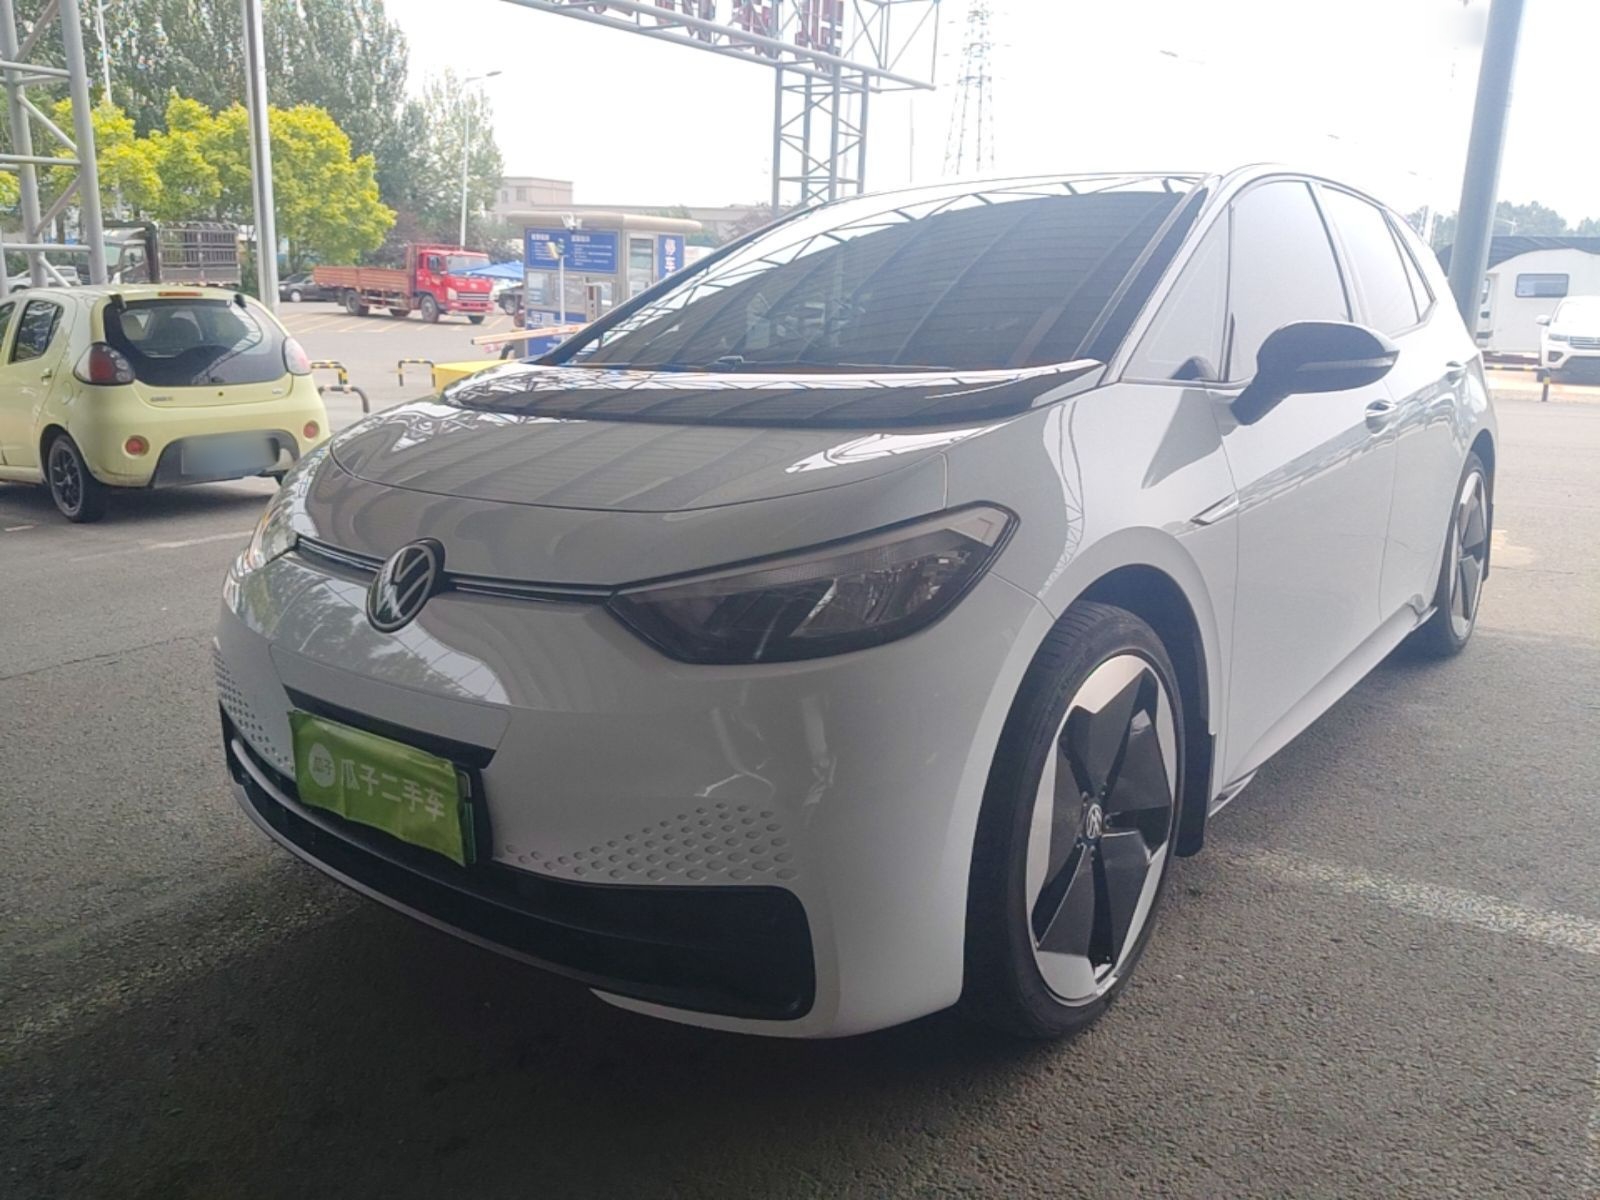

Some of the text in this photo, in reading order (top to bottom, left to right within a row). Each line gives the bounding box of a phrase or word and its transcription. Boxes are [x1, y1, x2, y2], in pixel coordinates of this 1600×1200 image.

[341, 759, 445, 822] 瓜子二手车
